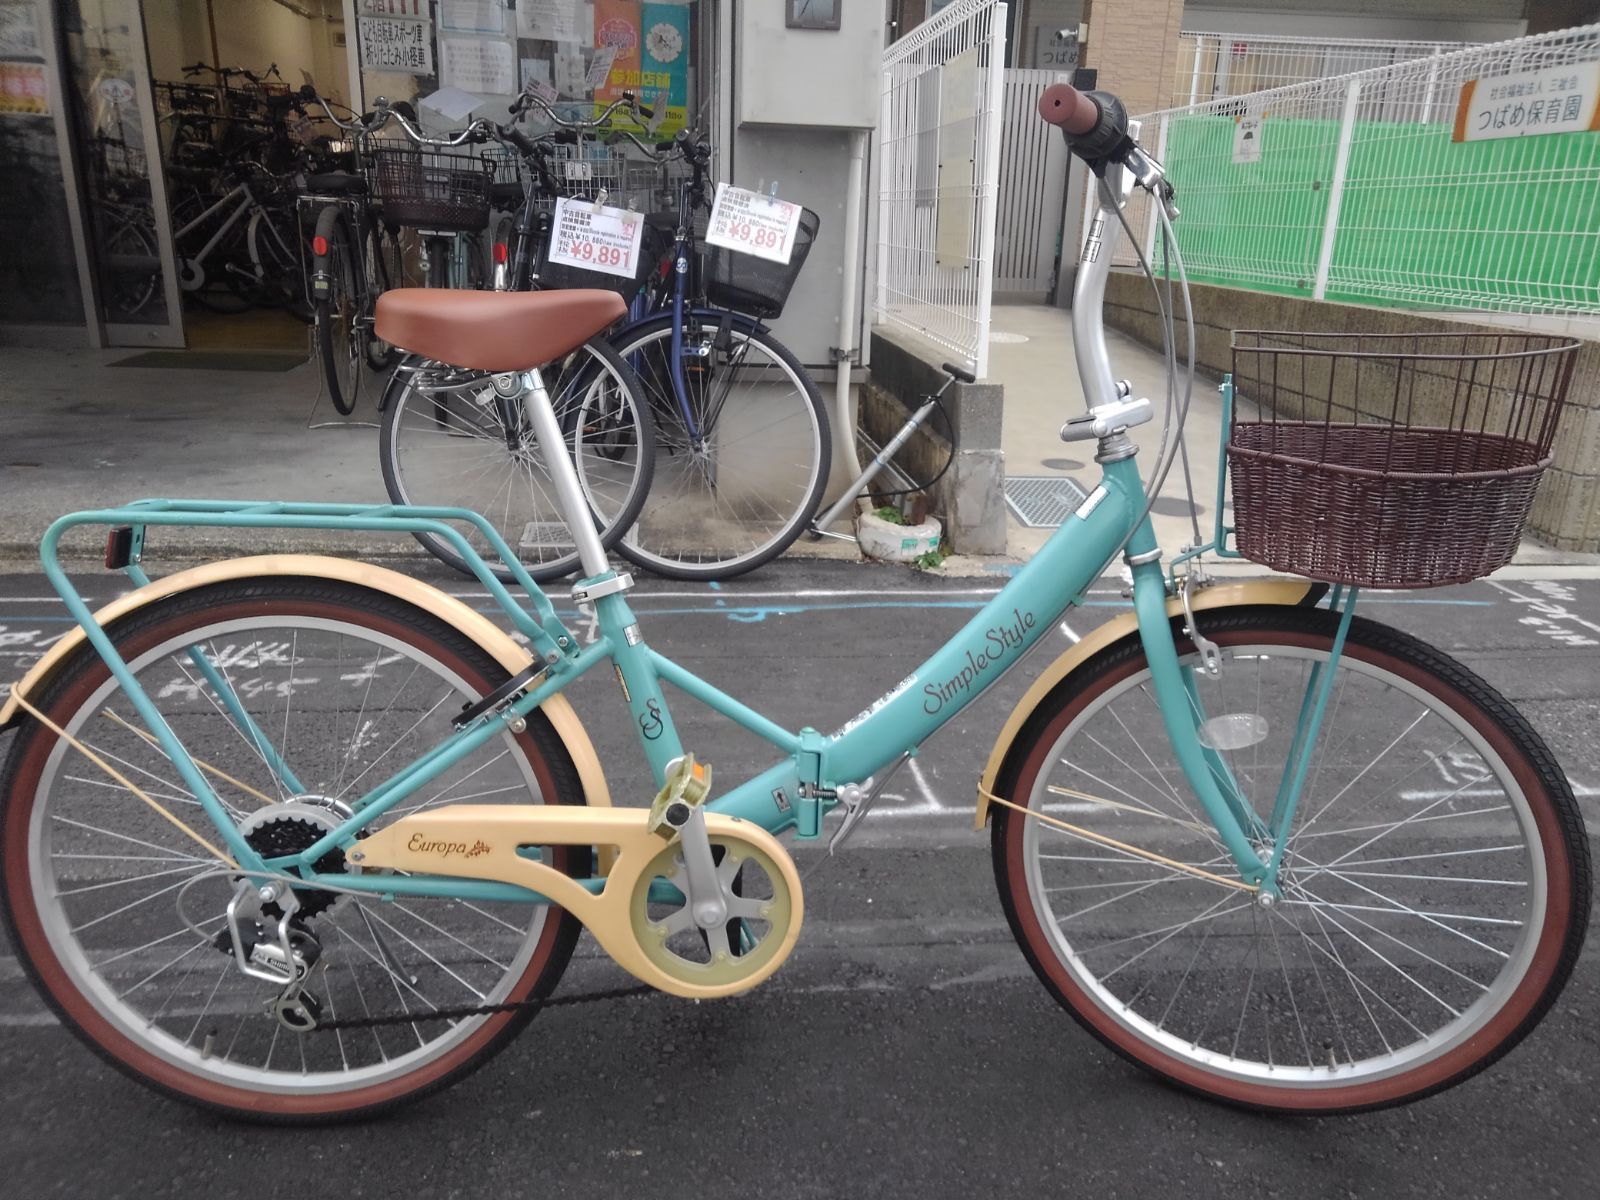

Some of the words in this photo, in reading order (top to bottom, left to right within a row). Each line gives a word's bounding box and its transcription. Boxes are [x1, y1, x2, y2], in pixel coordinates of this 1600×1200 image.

[1478, 95, 1582, 130] つばめ保育園
[728, 220, 786, 252] ¥9,891
[571, 240, 630, 268] ¥9,891
[408, 832, 466, 858] Europa
